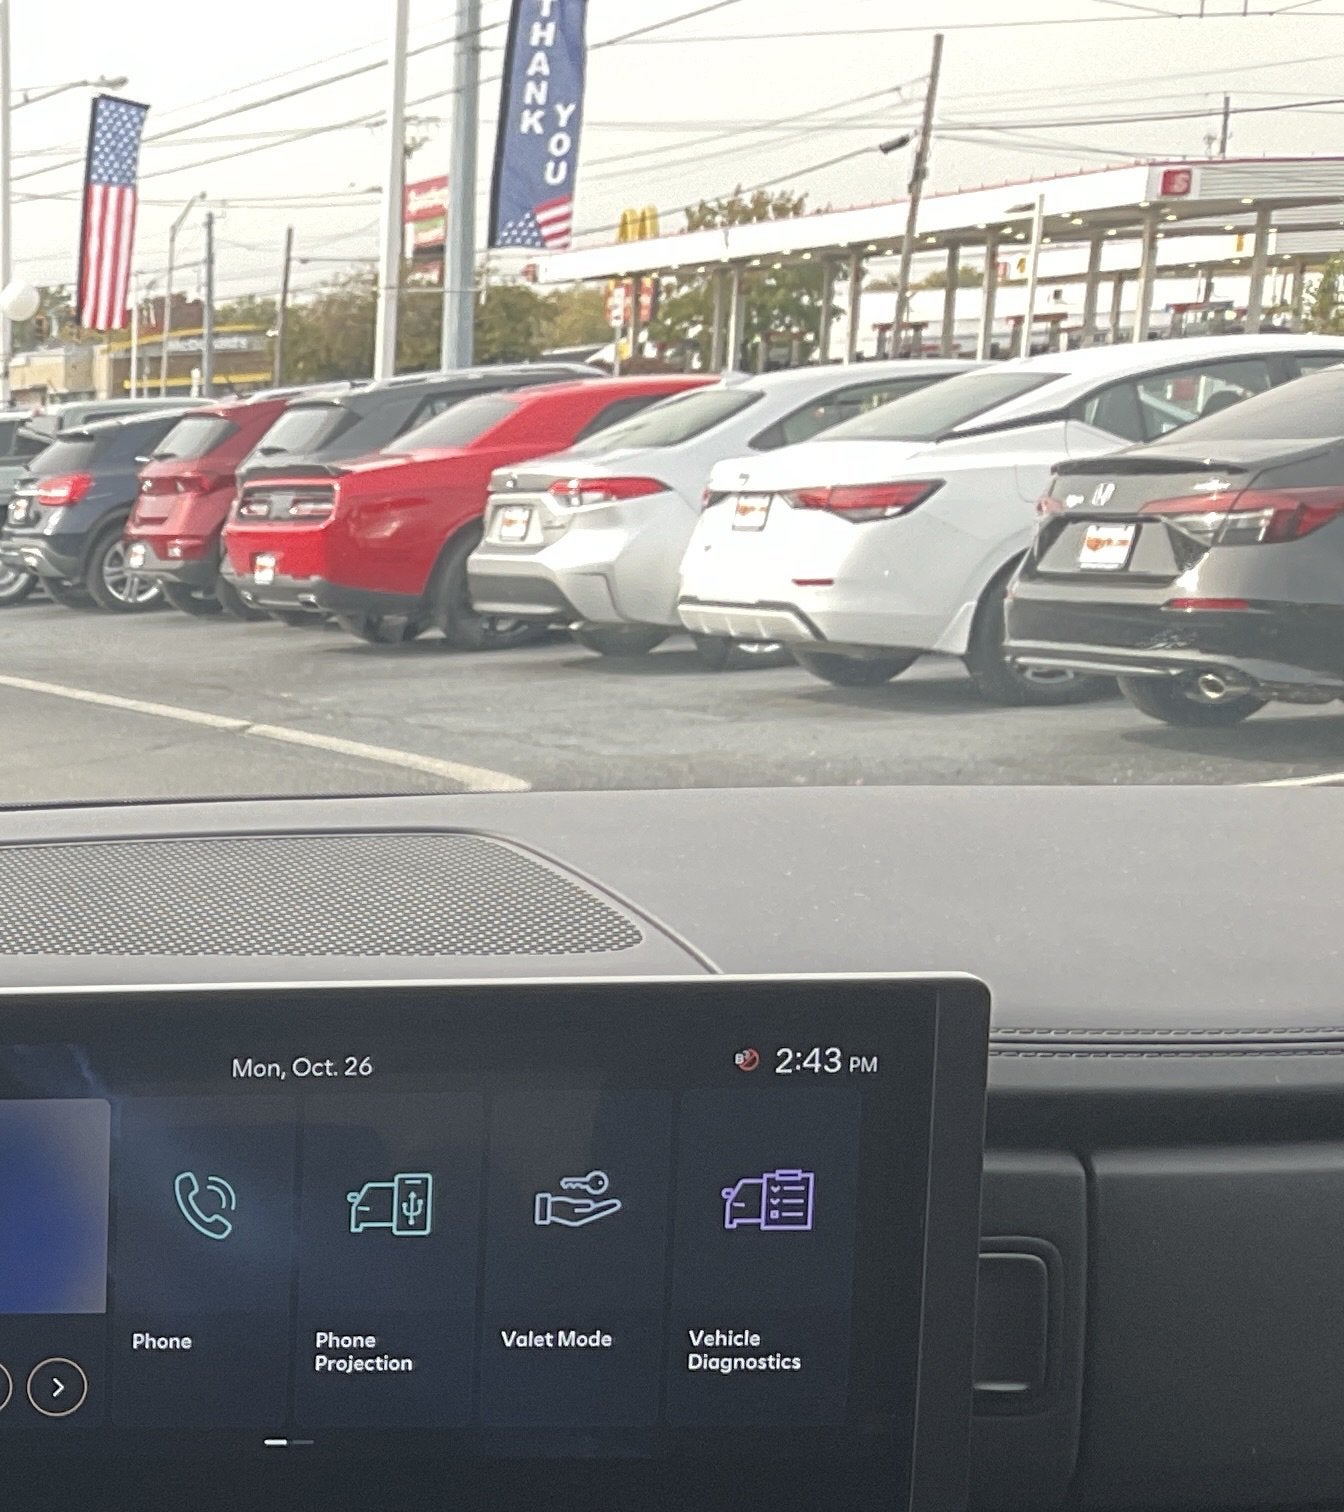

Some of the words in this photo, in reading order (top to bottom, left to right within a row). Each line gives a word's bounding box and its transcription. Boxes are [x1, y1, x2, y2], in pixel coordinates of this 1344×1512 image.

[520, 0, 558, 135] THANK
[545, 102, 576, 186] YOU
[232, 1058, 286, 1080] Mon,
[292, 1056, 339, 1079] Oct.
[344, 1055, 374, 1076] 26
[775, 1047, 843, 1074] 2:43
[849, 1056, 879, 1073] PM
[132, 1333, 193, 1350] Phone
[315, 1332, 377, 1349] Phone
[501, 1330, 554, 1348] Valet
[557, 1330, 613, 1348] Mode
[688, 1329, 761, 1347] Vehicle
[314, 1354, 413, 1374] Projection
[688, 1353, 802, 1374] Diagnostics
